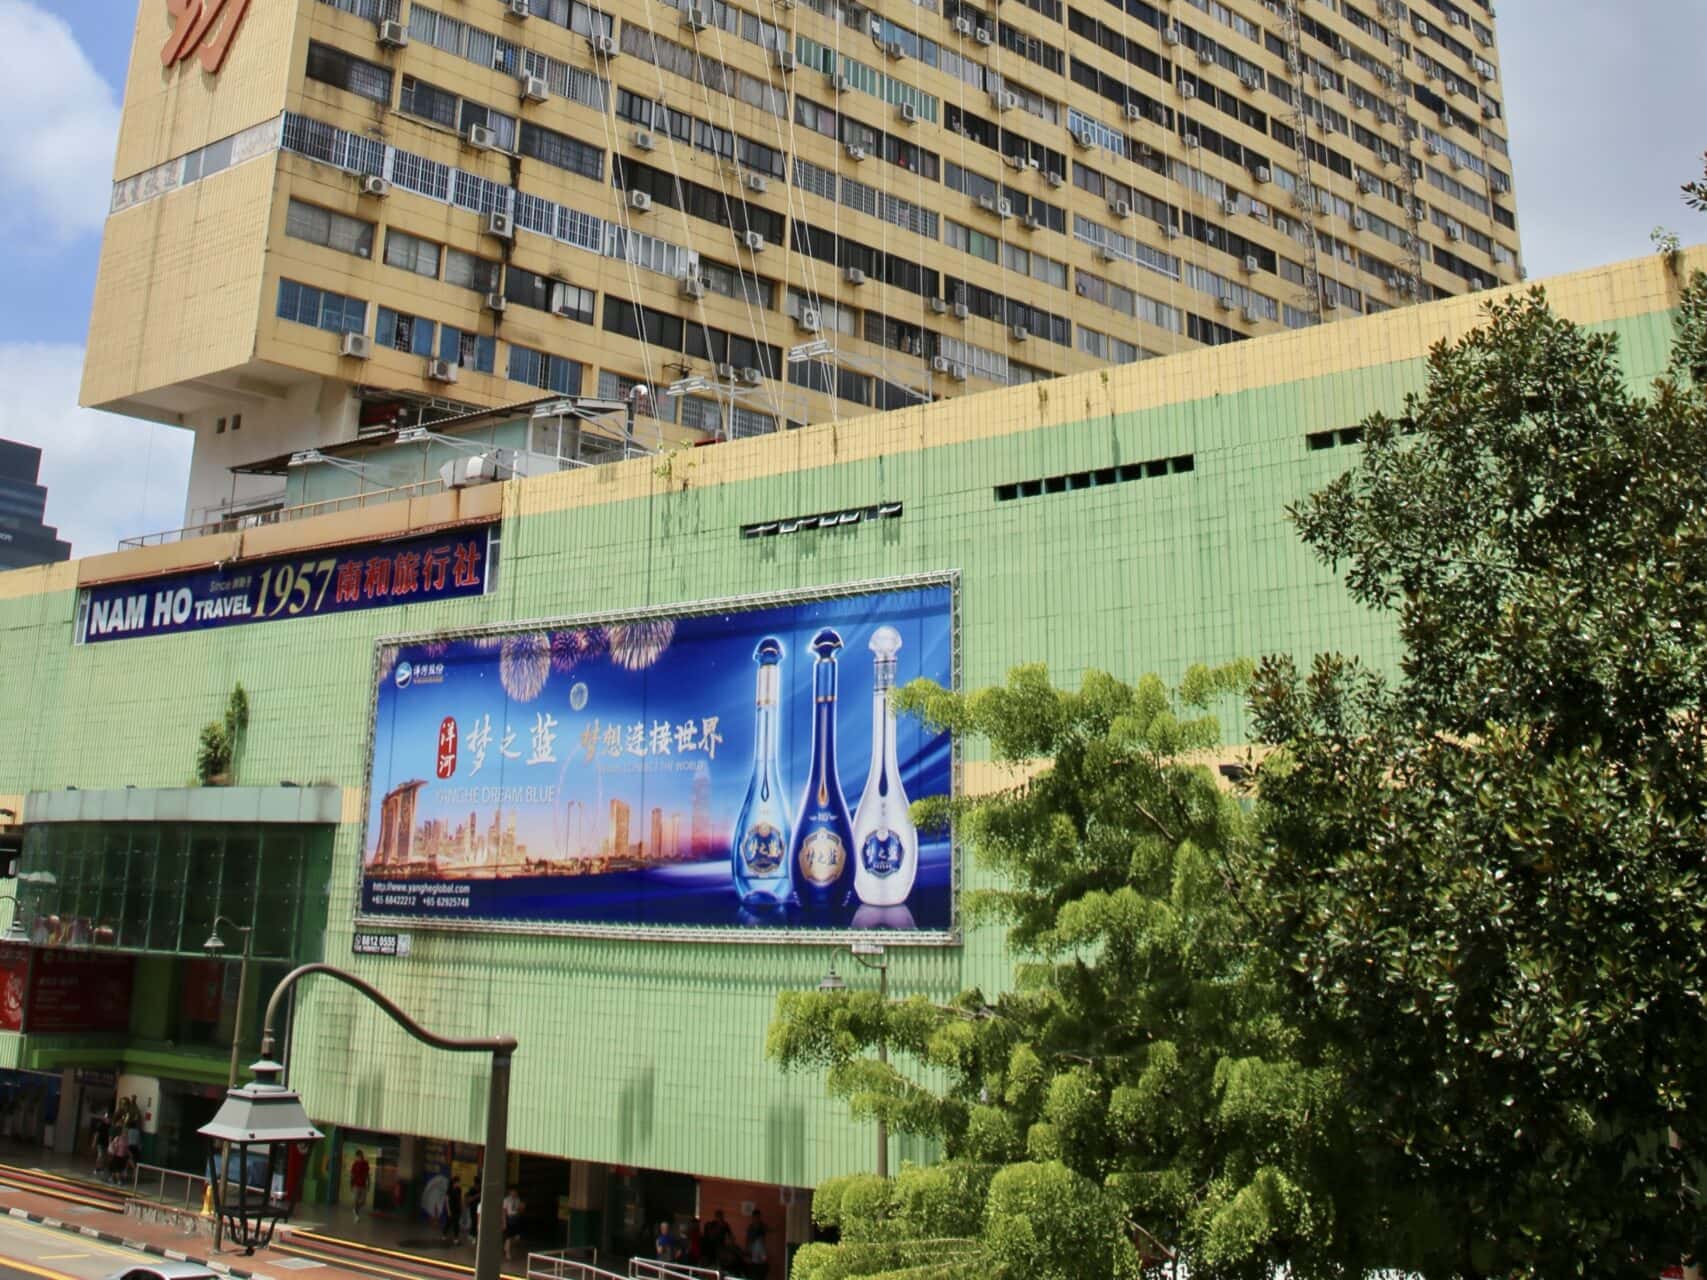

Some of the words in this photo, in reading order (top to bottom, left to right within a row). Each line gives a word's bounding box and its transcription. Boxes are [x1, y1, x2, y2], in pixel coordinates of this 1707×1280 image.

[251, 558, 337, 619] 1957
[335, 540, 482, 604] 南和旅行社
[89, 594, 147, 635] NAM
[152, 587, 193, 627] HO
[194, 593, 252, 621] TRAVEL
[438, 721, 456, 776] 洋河
[465, 712, 558, 777] 梦之蓝
[579, 715, 724, 763] 梦想连接世界
[481, 785, 524, 803] DREAM
[526, 784, 556, 802] BLUE
[372, 895, 384, 905] +65
[422, 897, 435, 907] +65
